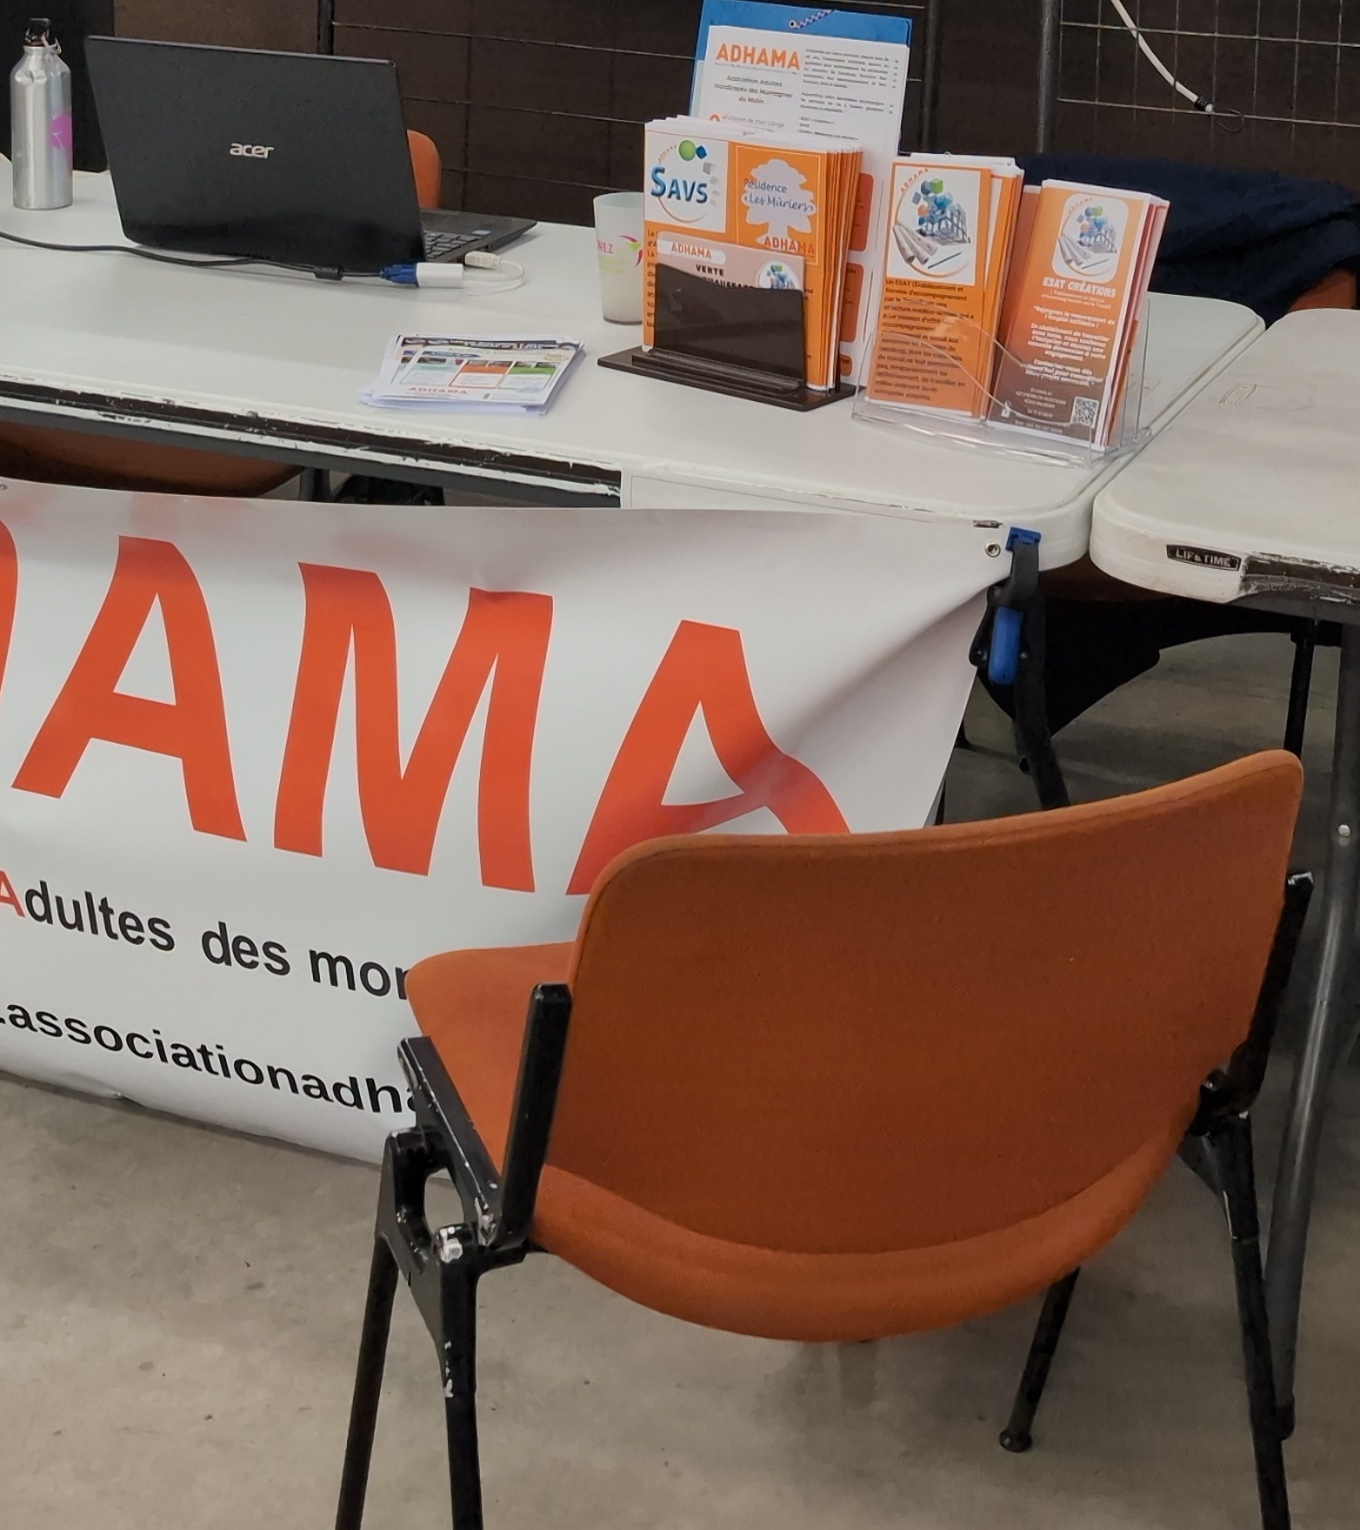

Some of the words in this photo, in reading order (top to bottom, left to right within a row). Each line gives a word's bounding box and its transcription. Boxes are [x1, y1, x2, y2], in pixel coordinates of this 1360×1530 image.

[716, 43, 800, 70] ADHAMA
[229, 141, 274, 159] acer
[744, 178, 787, 194] Résidence
[671, 244, 712, 260] ADHAMA
[764, 236, 815, 255] ADHAMA
[1043, 277, 1066, 289] ESAT
[1068, 281, 1116, 298] CRÉATIONS
[201, 918, 292, 978] des
